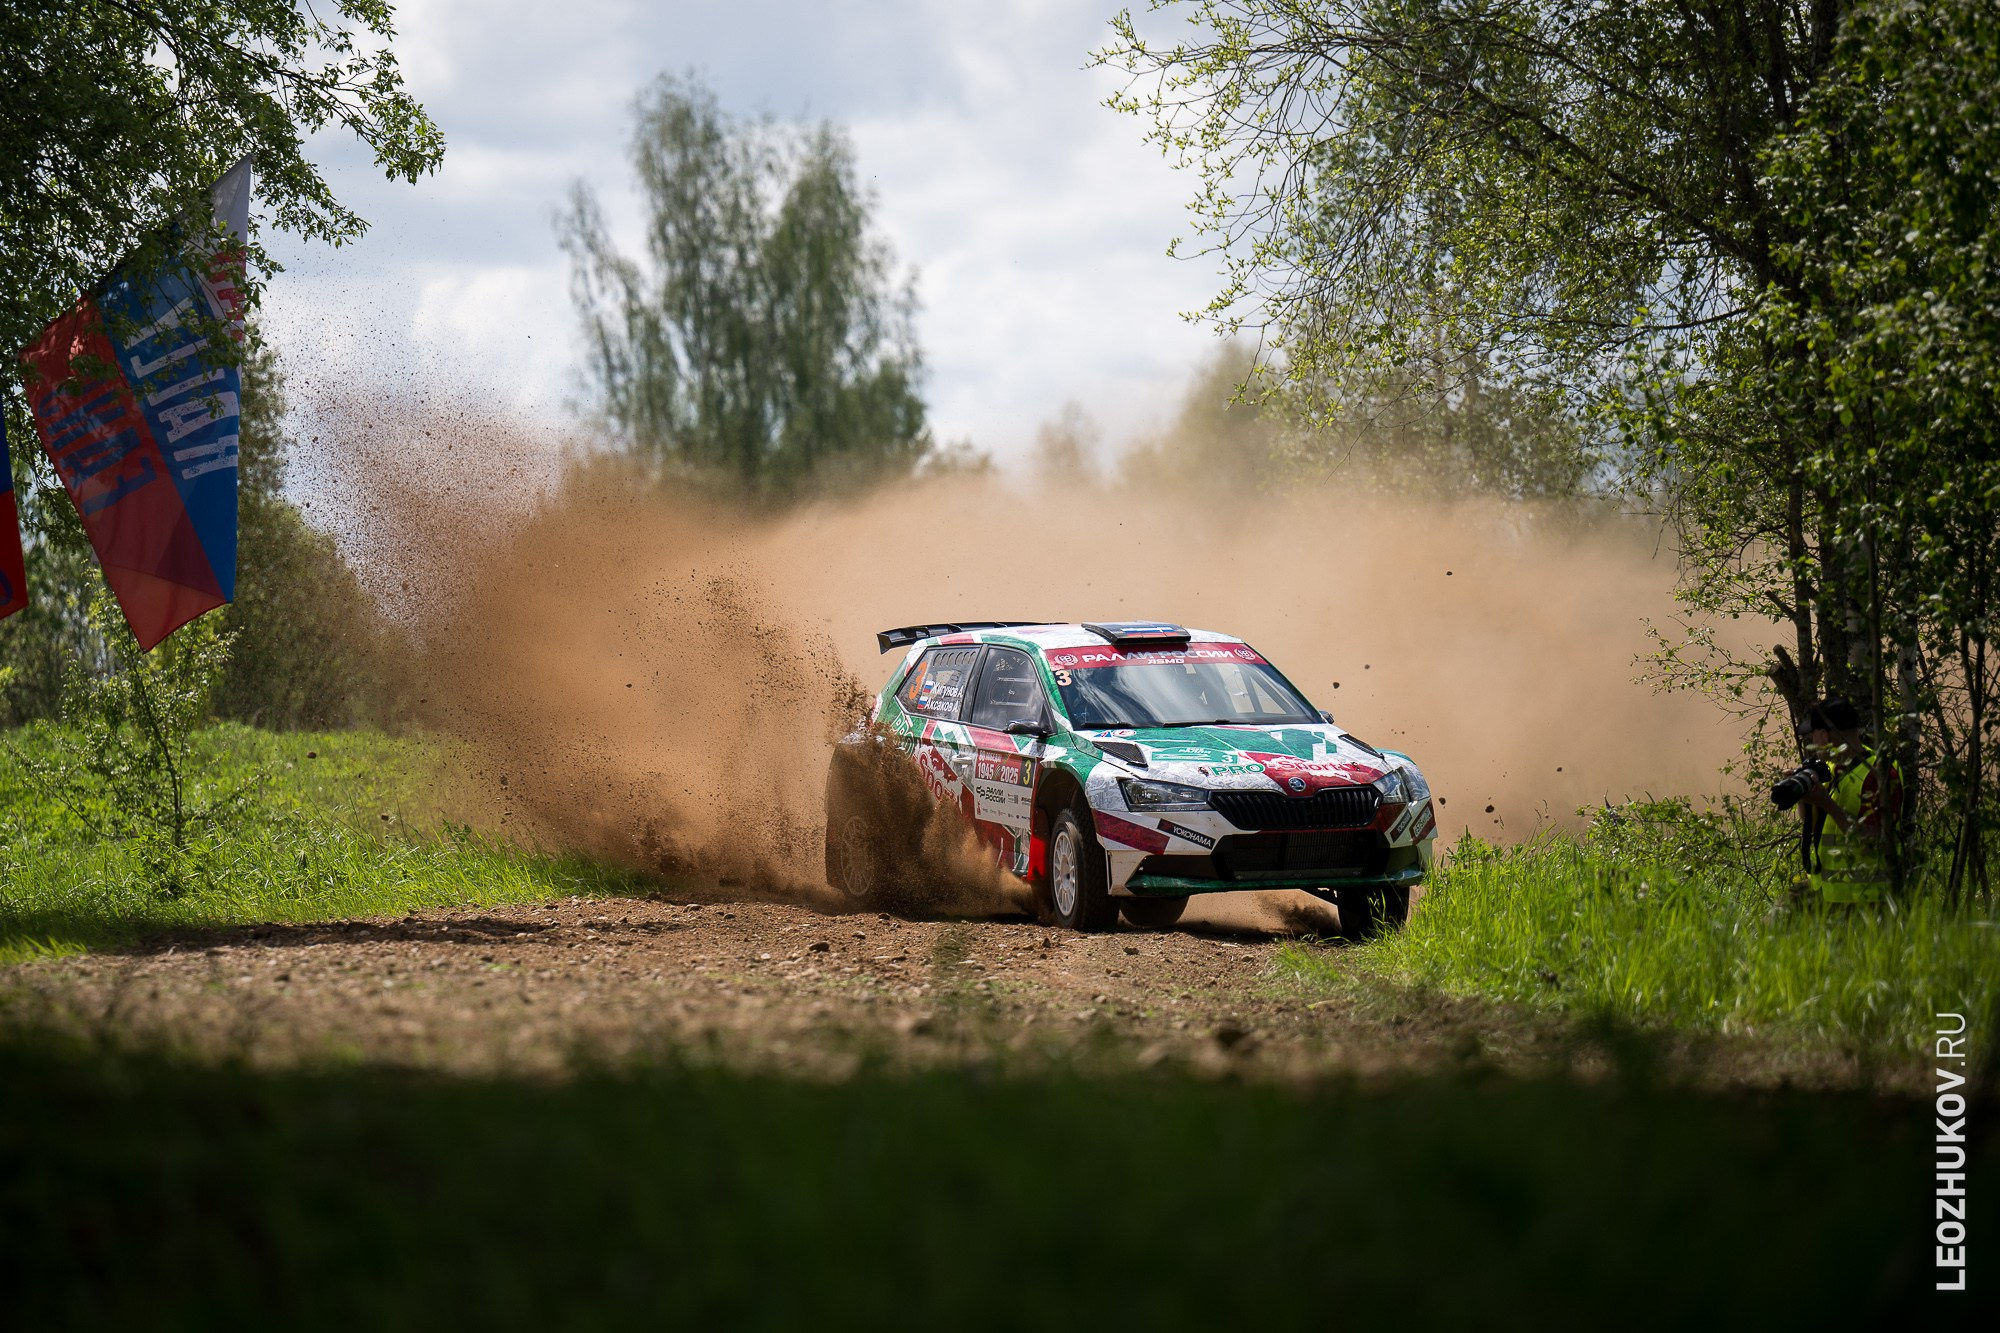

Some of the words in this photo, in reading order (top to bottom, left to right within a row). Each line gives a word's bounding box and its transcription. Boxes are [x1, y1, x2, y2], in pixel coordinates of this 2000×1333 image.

[1082, 651, 1154, 663] РАЛЛИ
[1157, 650, 1234, 659] РОССИИ
[909, 661, 928, 700] 3
[1055, 670, 1072, 686] 3
[930, 681, 958, 698] Жигунов
[924, 697, 953, 712] Аксаков
[1222, 755, 1233, 763] 3
[978, 762, 994, 780] 1945
[1000, 766, 1019, 784] 2025
[1023, 759, 1032, 785] 3
[985, 794, 1006, 804] РОССИИ
[986, 787, 1004, 796] РАЛЛИ
[1173, 826, 1211, 847] YOKOHAMA
